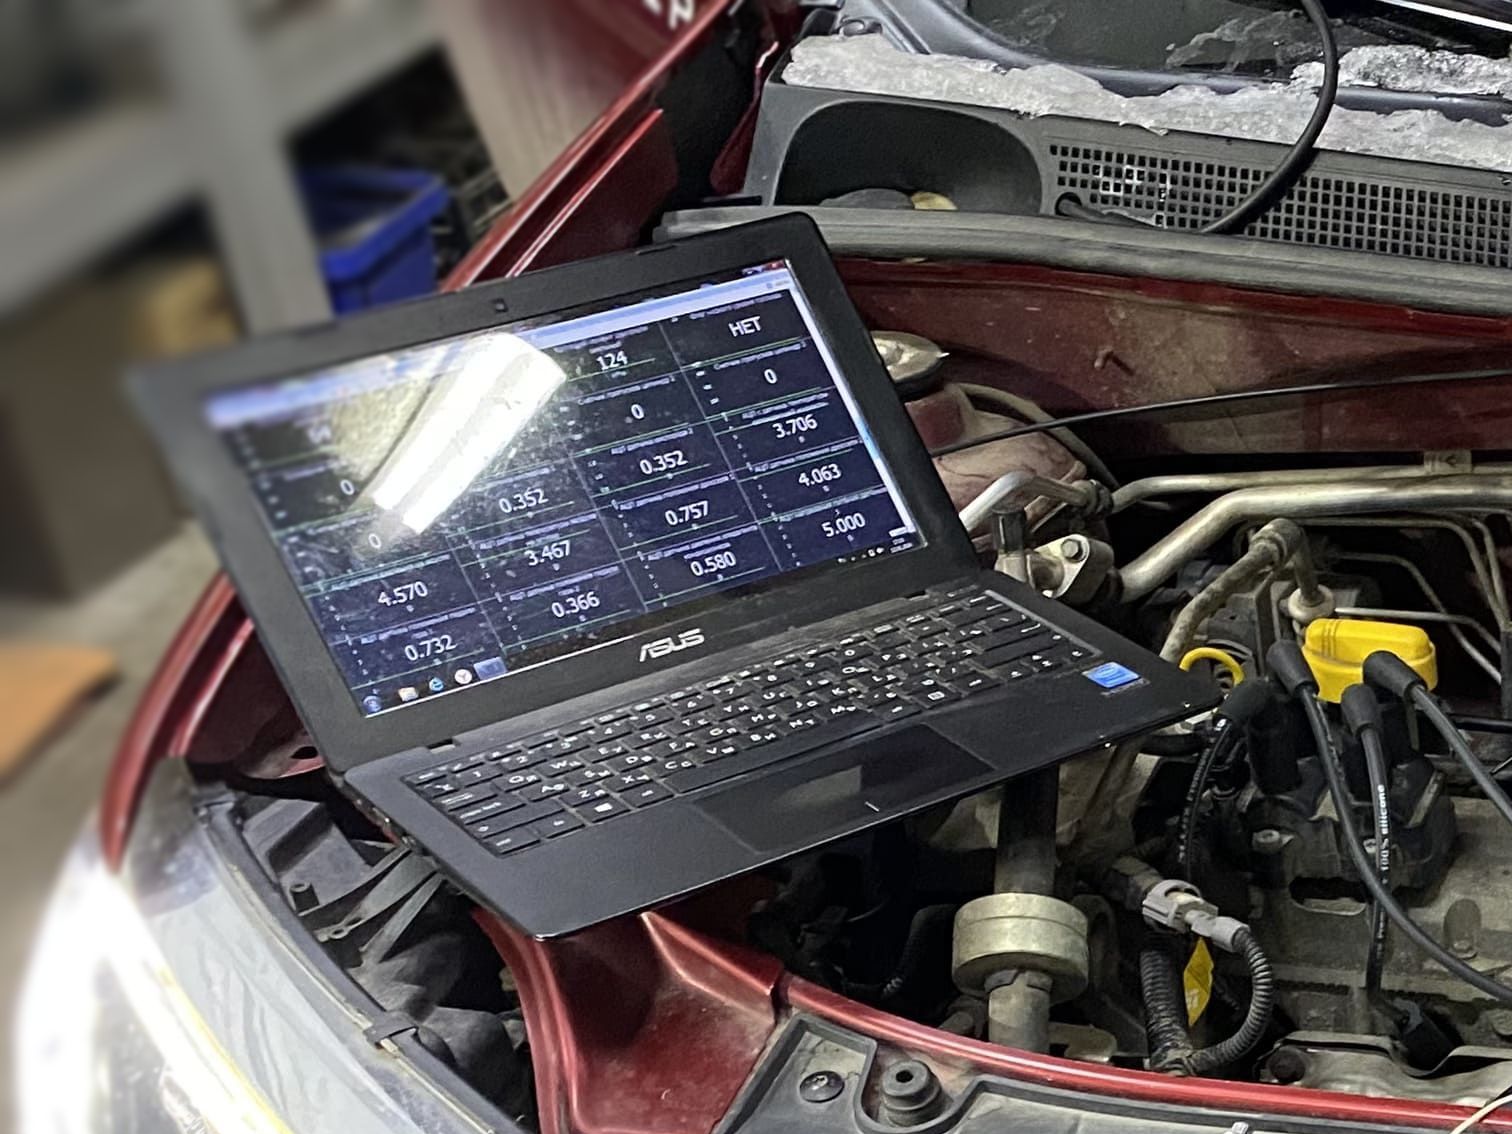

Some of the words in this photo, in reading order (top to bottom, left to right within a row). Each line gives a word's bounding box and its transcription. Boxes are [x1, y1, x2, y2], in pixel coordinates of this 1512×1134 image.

[728, 315, 764, 338] НЕТ
[596, 350, 629, 372] 124
[763, 368, 778, 385] 0
[630, 404, 645, 420] 0
[772, 414, 818, 440] 3.706
[639, 450, 689, 476] 0.352
[797, 463, 842, 487] 4.063
[498, 488, 549, 514] 0.352
[664, 500, 709, 526] 0.757
[821, 512, 867, 538] 5.000
[523, 539, 571, 567] 3.467
[690, 551, 737, 577] 0.580
[377, 580, 429, 607] 4.570
[550, 591, 600, 618] 0.366
[404, 634, 457, 662] 0.732
[639, 627, 705, 663] ASUS
